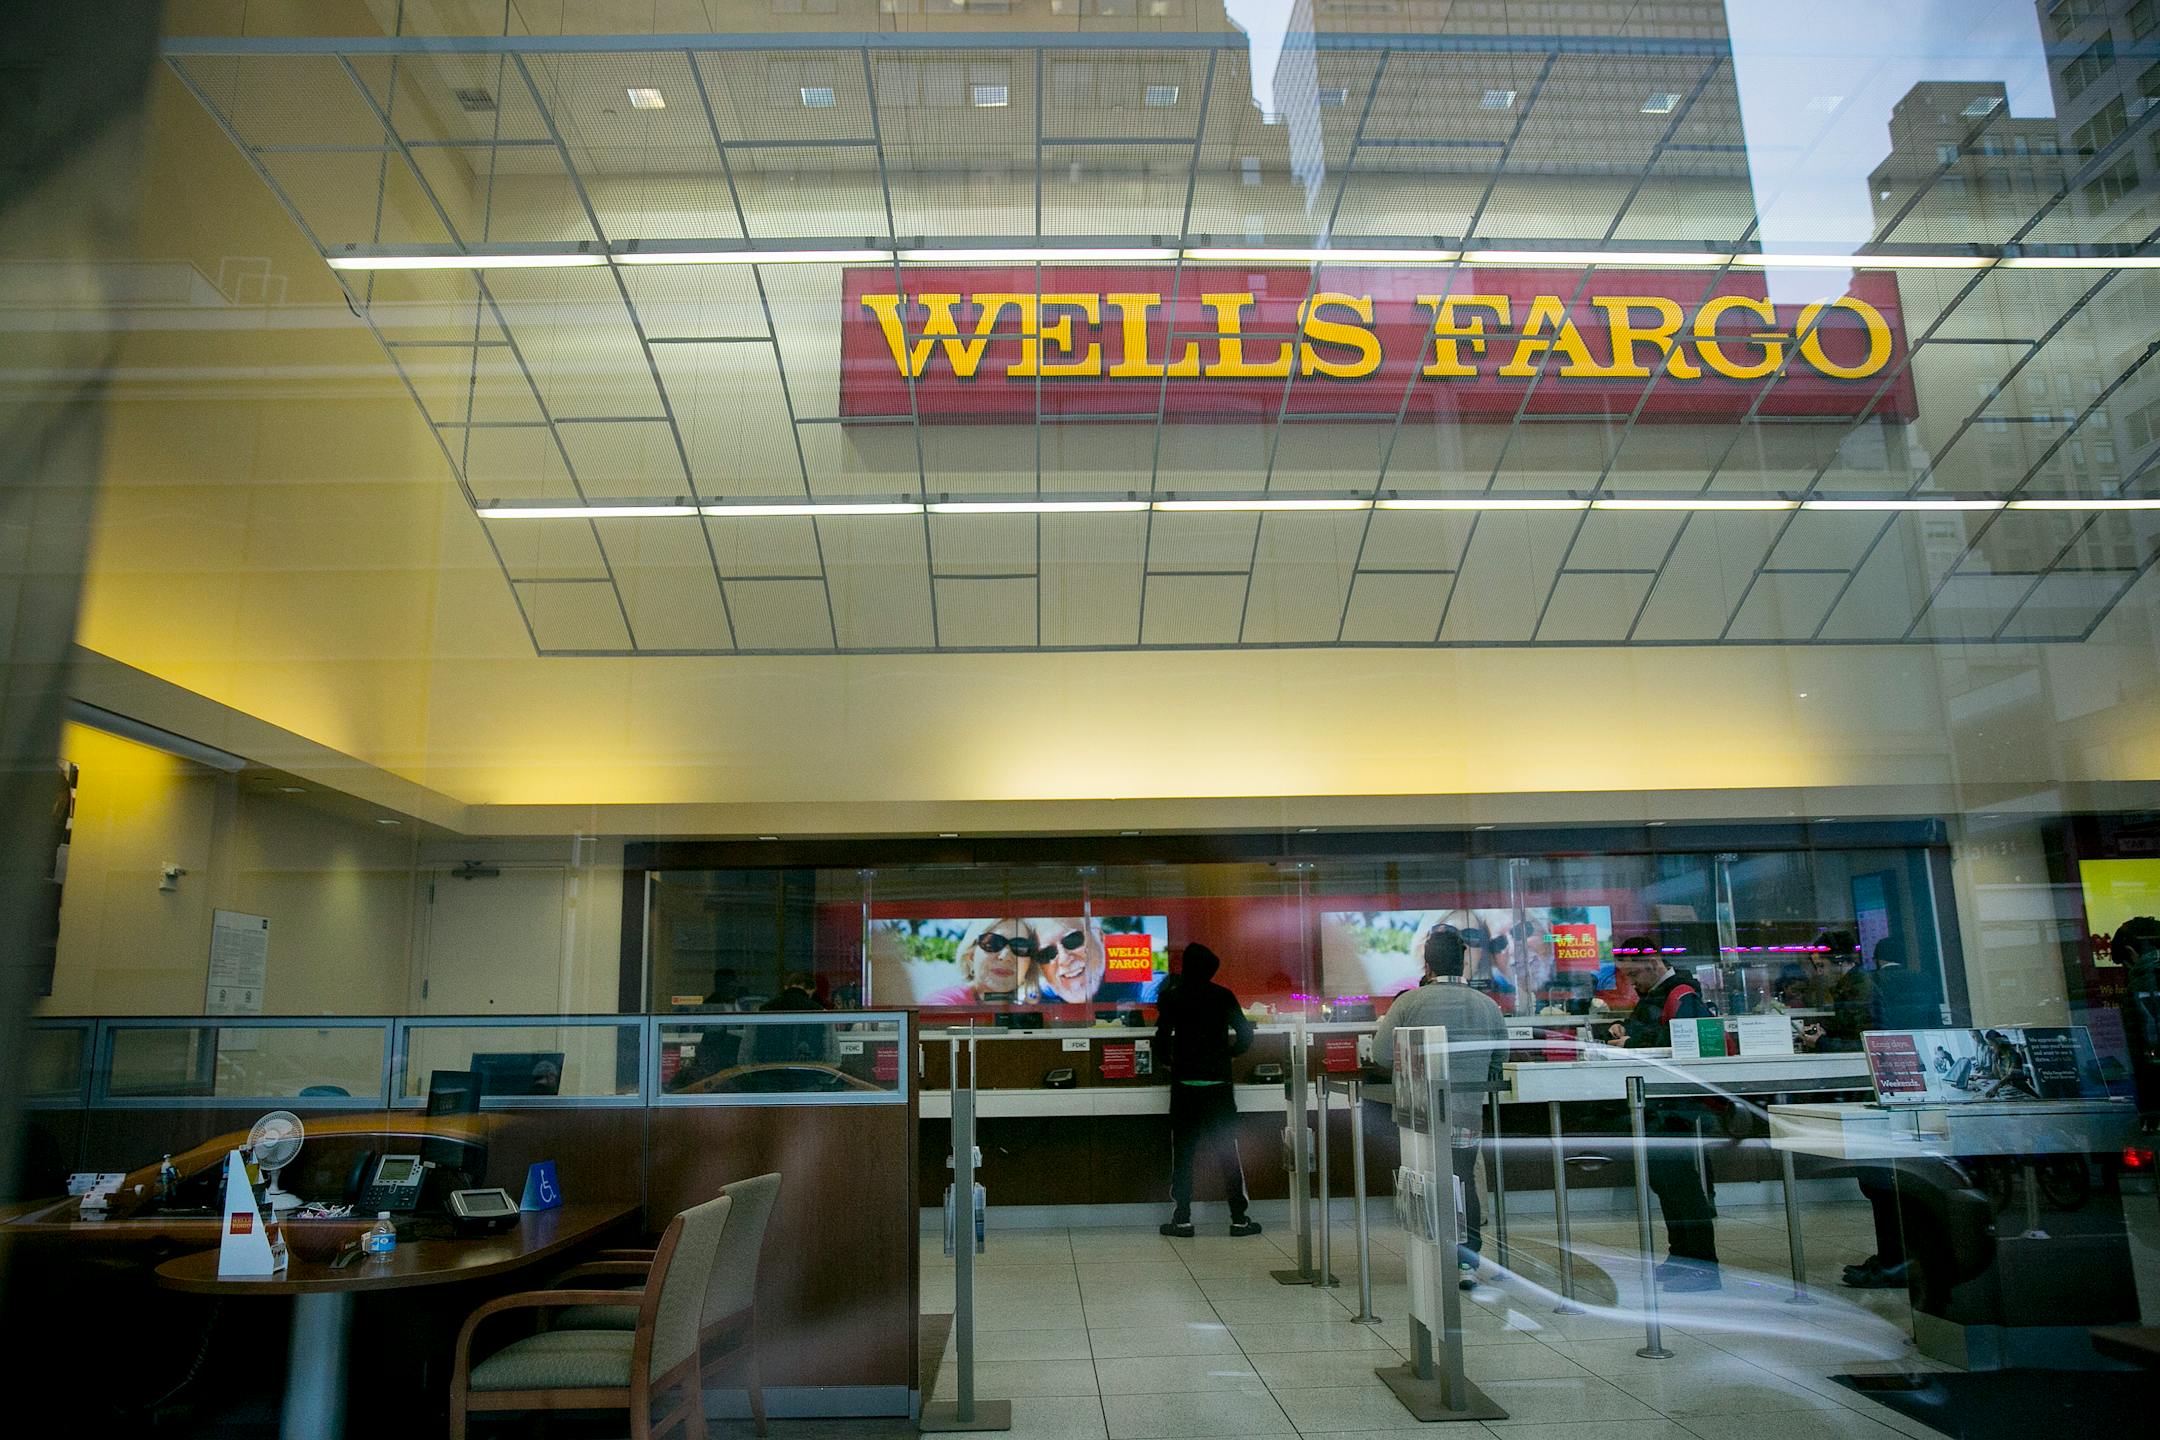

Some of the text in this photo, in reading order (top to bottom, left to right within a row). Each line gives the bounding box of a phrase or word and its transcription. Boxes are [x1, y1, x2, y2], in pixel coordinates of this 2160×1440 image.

[861, 292, 1893, 379] WELLS FARGO
[1557, 937, 1596, 947] WELLS
[1107, 947, 1150, 957] WELLS
[1558, 949, 1596, 959] FARGO
[1109, 959, 1150, 969] FARGO
[1871, 1040, 1891, 1050] Long
[1880, 1078, 1920, 1088] Weekends.
